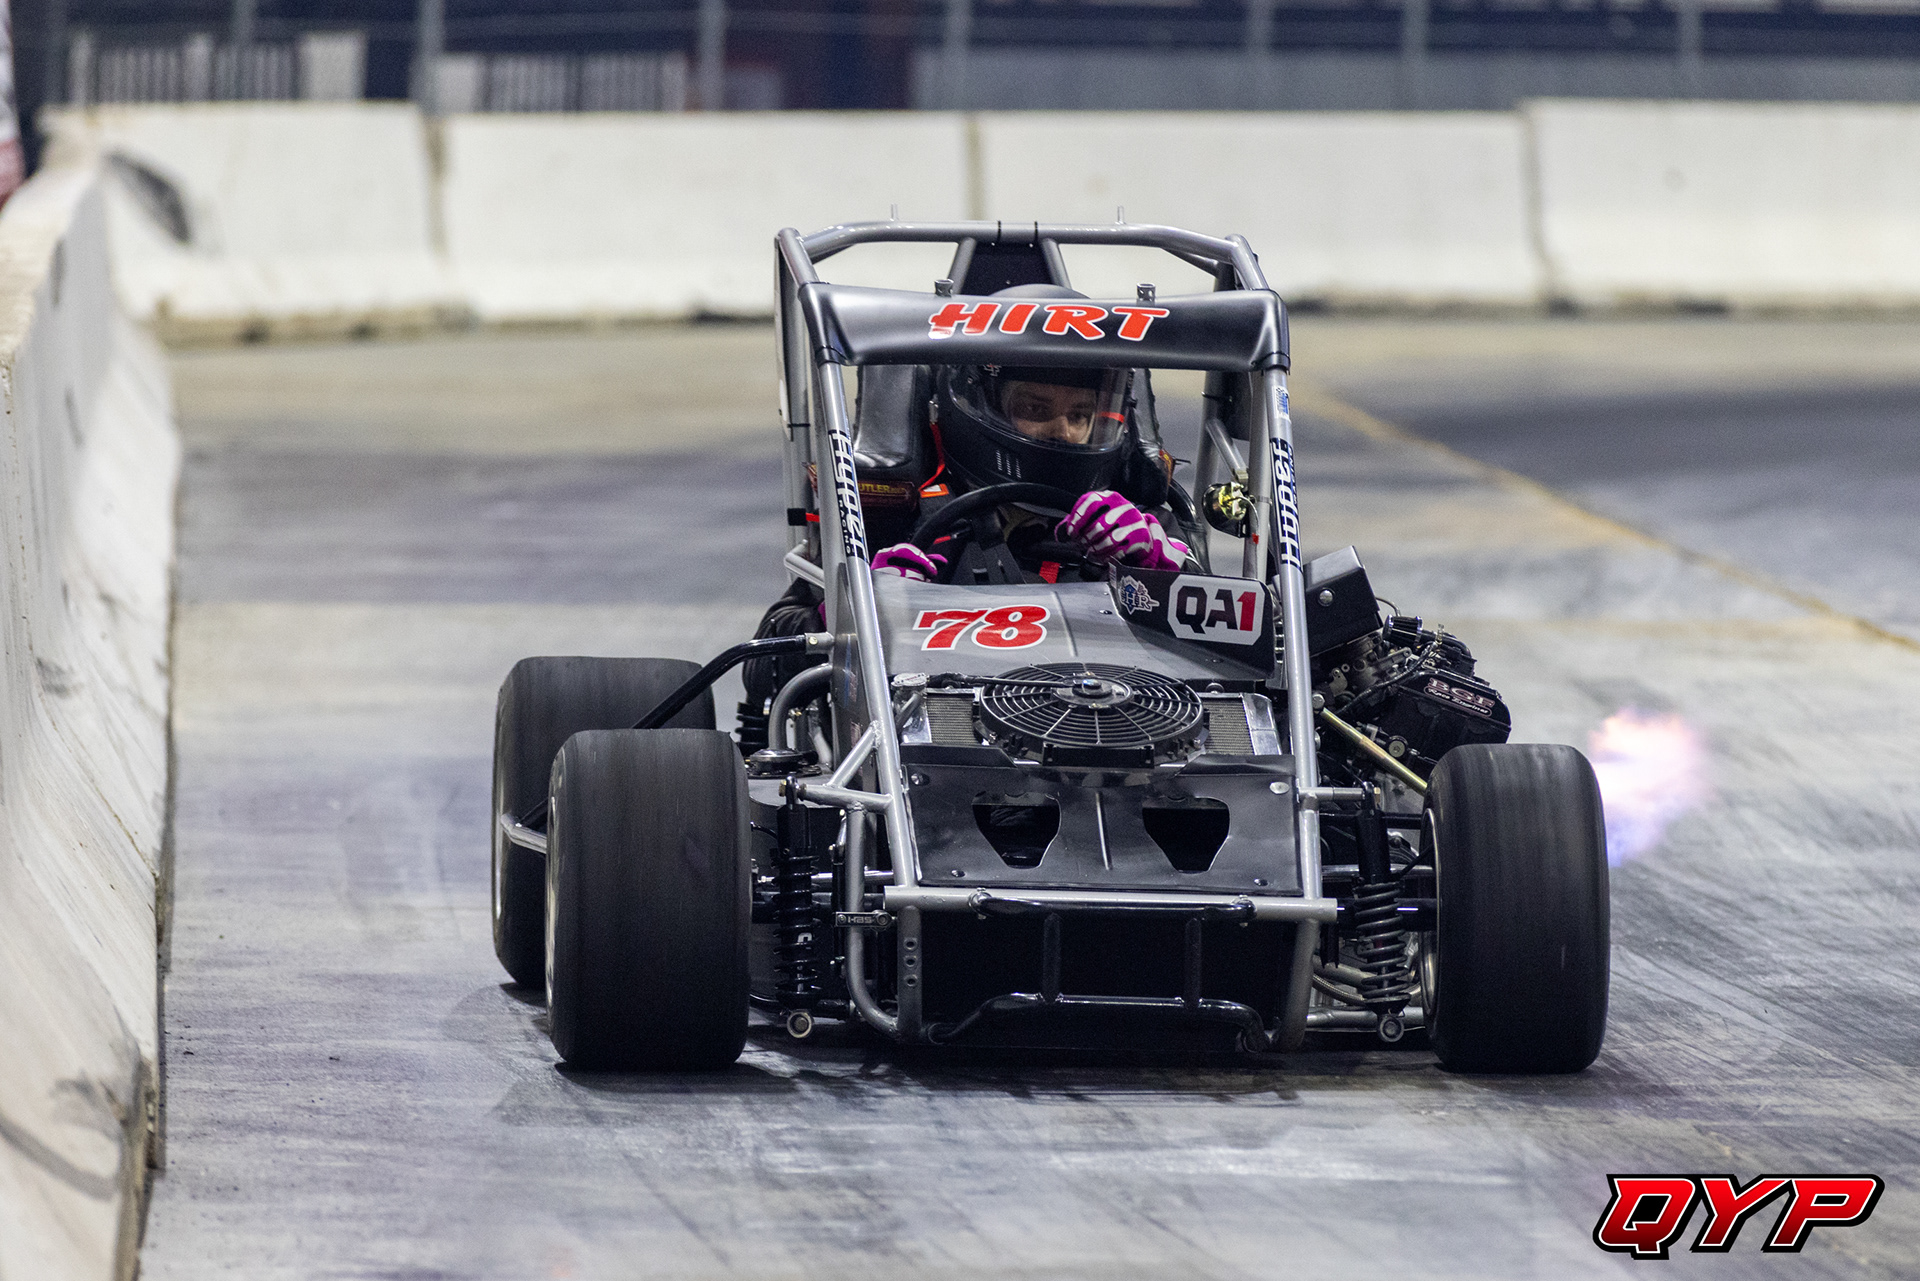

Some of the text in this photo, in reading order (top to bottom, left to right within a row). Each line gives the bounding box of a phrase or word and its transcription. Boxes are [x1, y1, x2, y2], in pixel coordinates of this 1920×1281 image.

[928, 302, 1170, 341] HIRT
[838, 501, 851, 554] RACING
[912, 604, 1051, 651] 78
[1176, 585, 1257, 634] QA1
